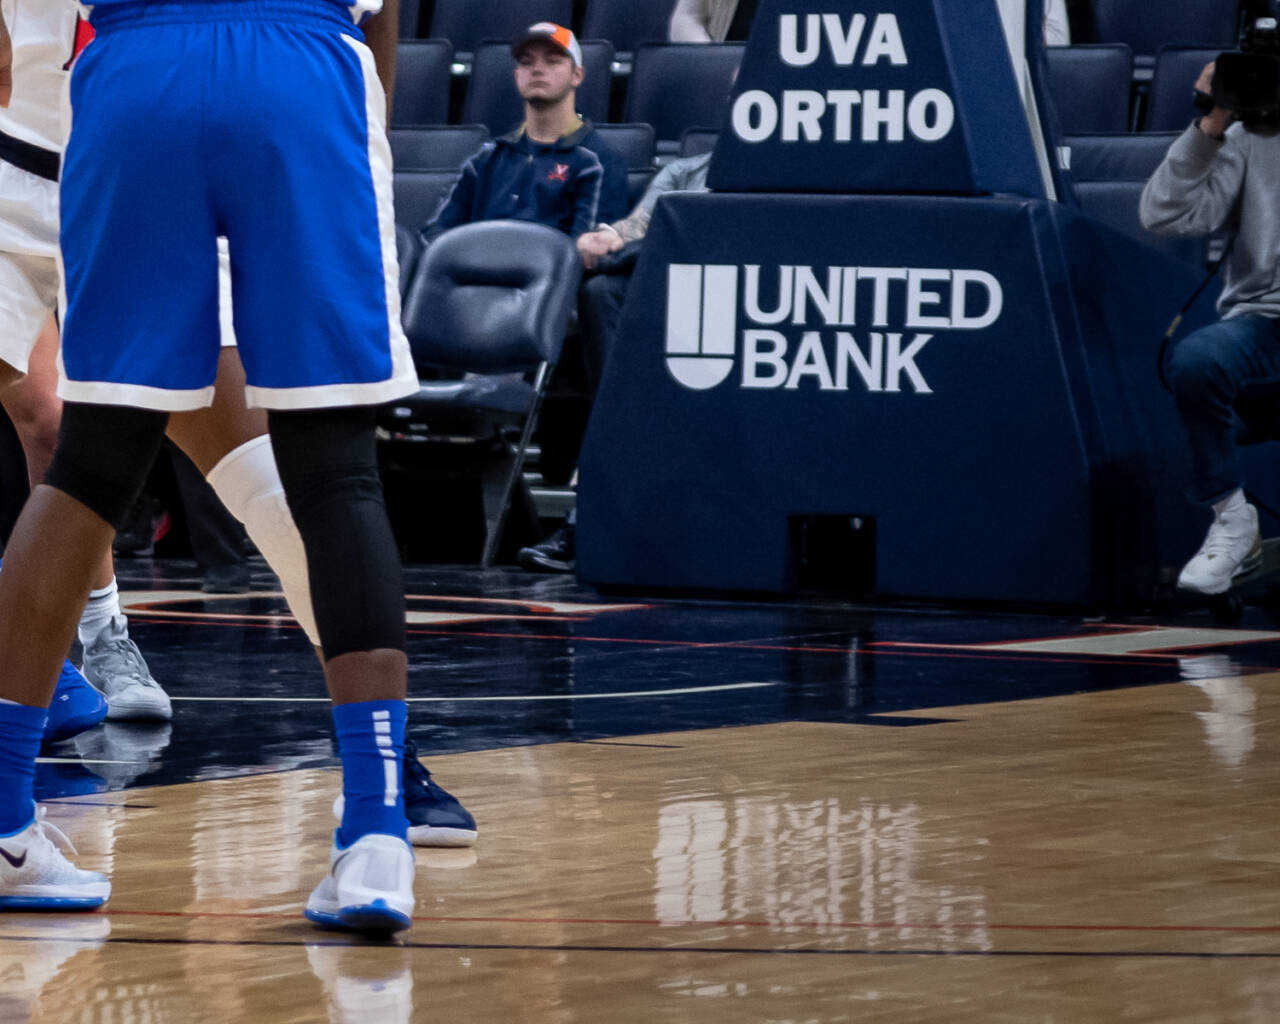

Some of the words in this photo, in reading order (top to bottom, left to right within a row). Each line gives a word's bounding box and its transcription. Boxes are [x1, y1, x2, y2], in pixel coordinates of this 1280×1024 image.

[779, 12, 909, 66] UVA
[731, 88, 955, 143] ORTHO
[743, 263, 1004, 330] UNITED
[740, 328, 935, 394] BANK
